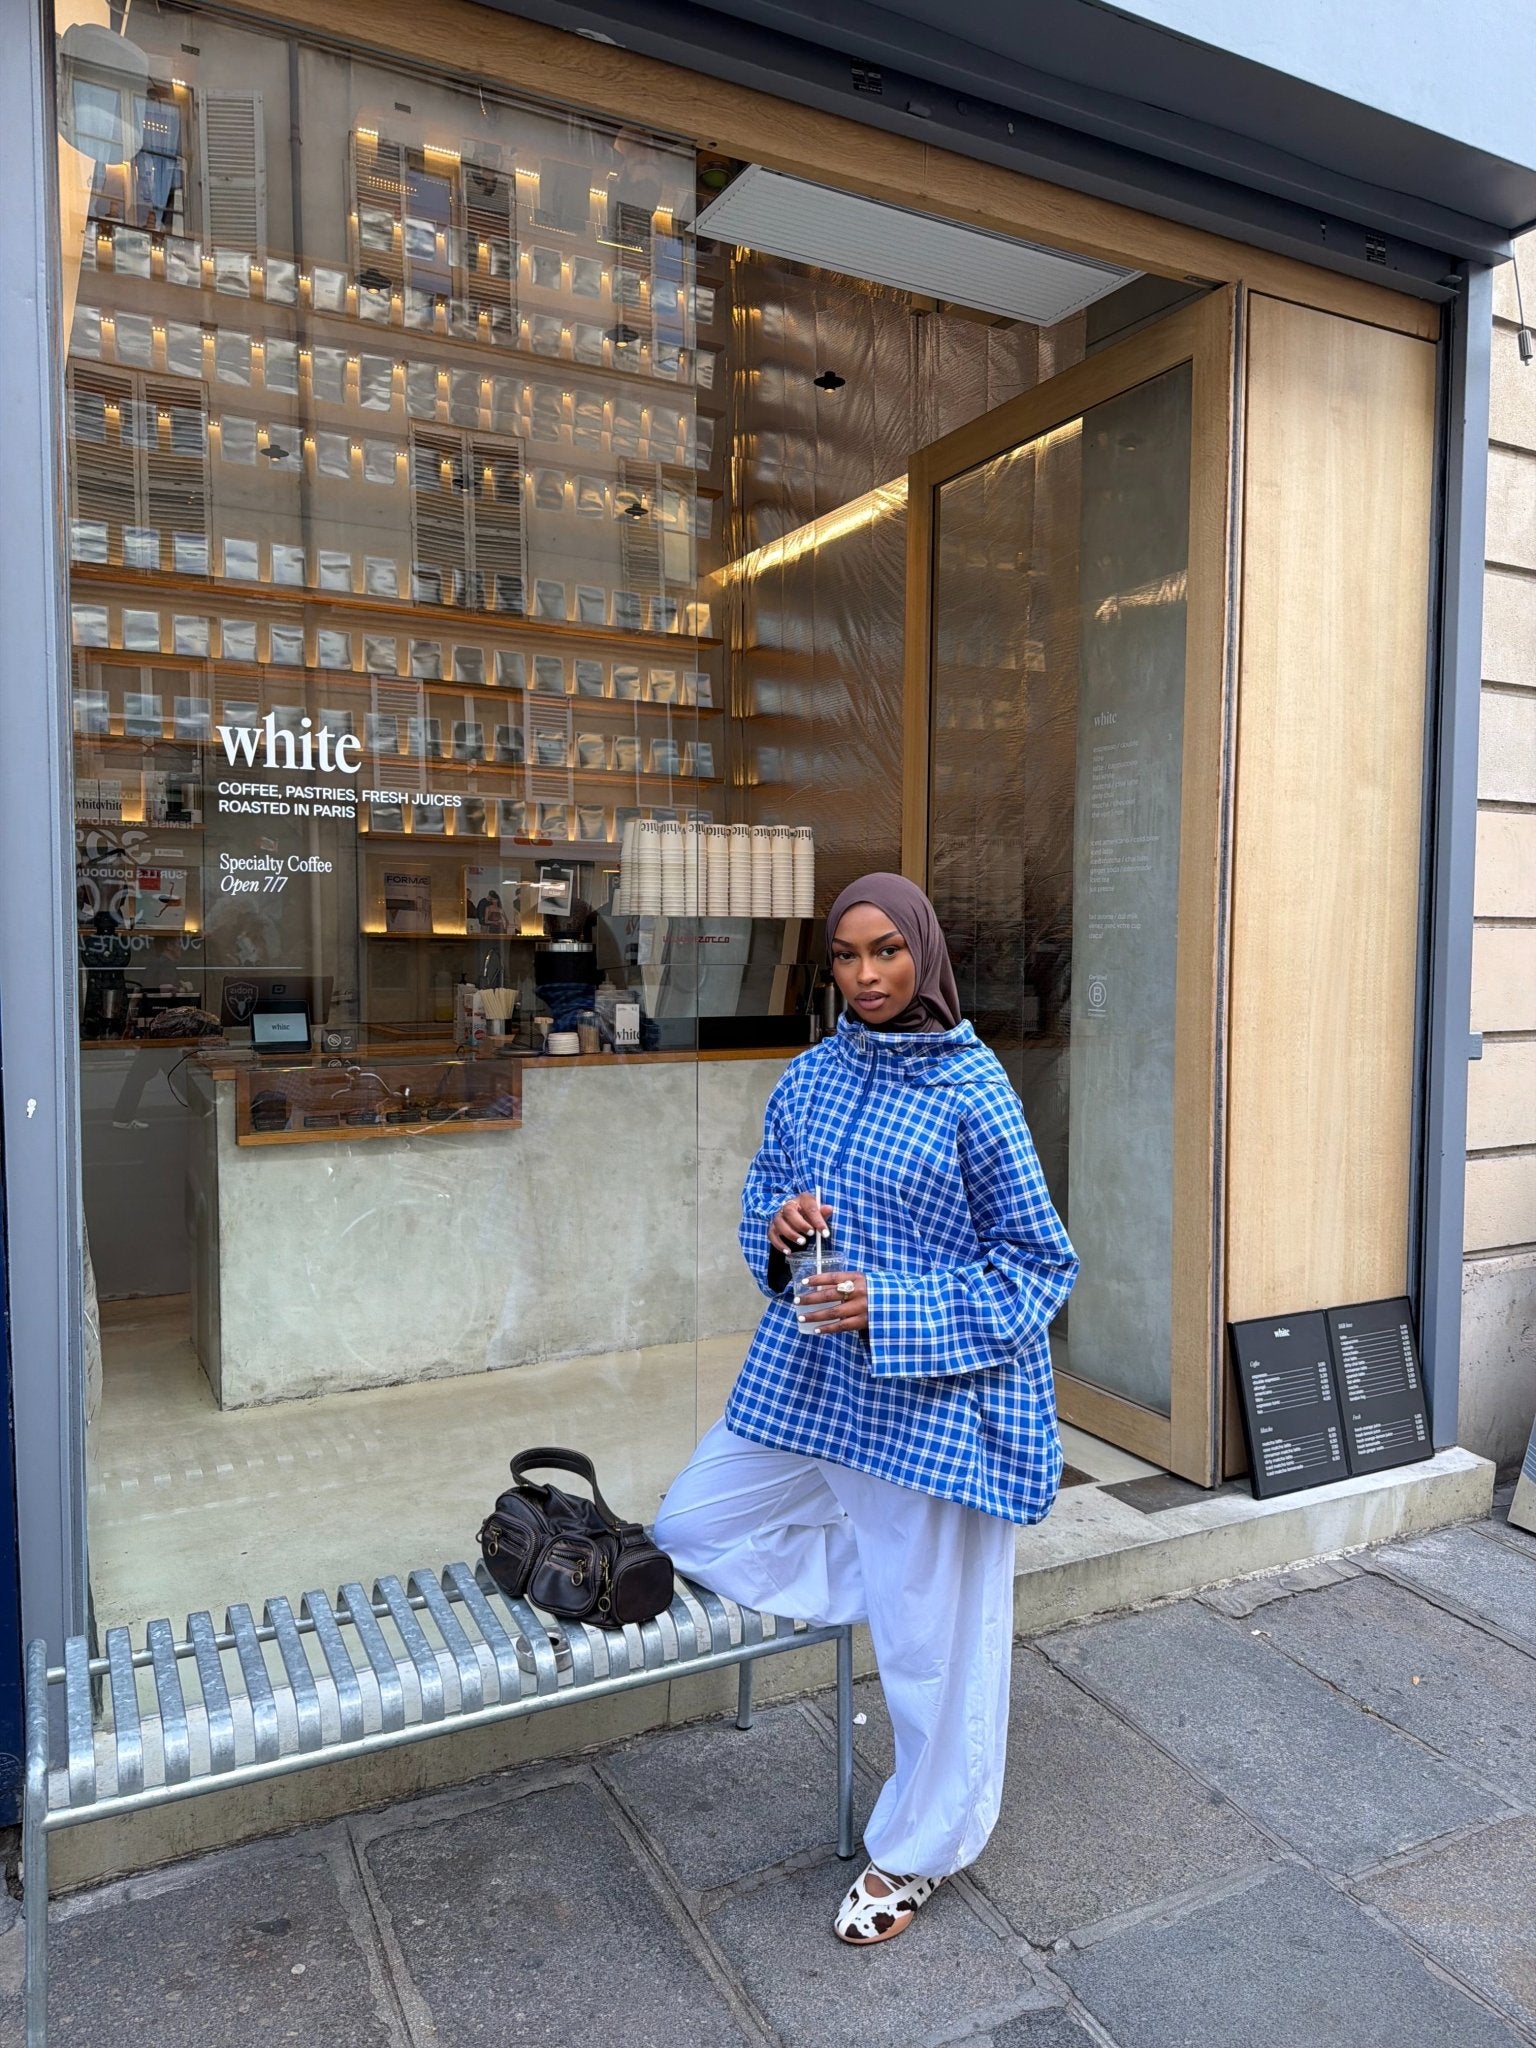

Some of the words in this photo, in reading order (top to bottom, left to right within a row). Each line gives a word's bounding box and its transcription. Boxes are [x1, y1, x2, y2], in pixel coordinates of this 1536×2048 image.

[1094, 711, 1118, 728] white
[216, 711, 362, 774] white
[217, 782, 282, 798] COFFEE,
[286, 786, 359, 803] PASTRIES,
[363, 790, 409, 804] FRESH
[412, 793, 462, 808] JUICES
[218, 799, 291, 815] ROASTED
[294, 803, 310, 816] IN
[313, 805, 356, 818] PARIS
[219, 853, 284, 875] Specialty
[287, 855, 333, 873] Coffee
[220, 875, 260, 896] Open
[262, 876, 289, 893] 7/7
[1273, 1327, 1290, 1338] white
